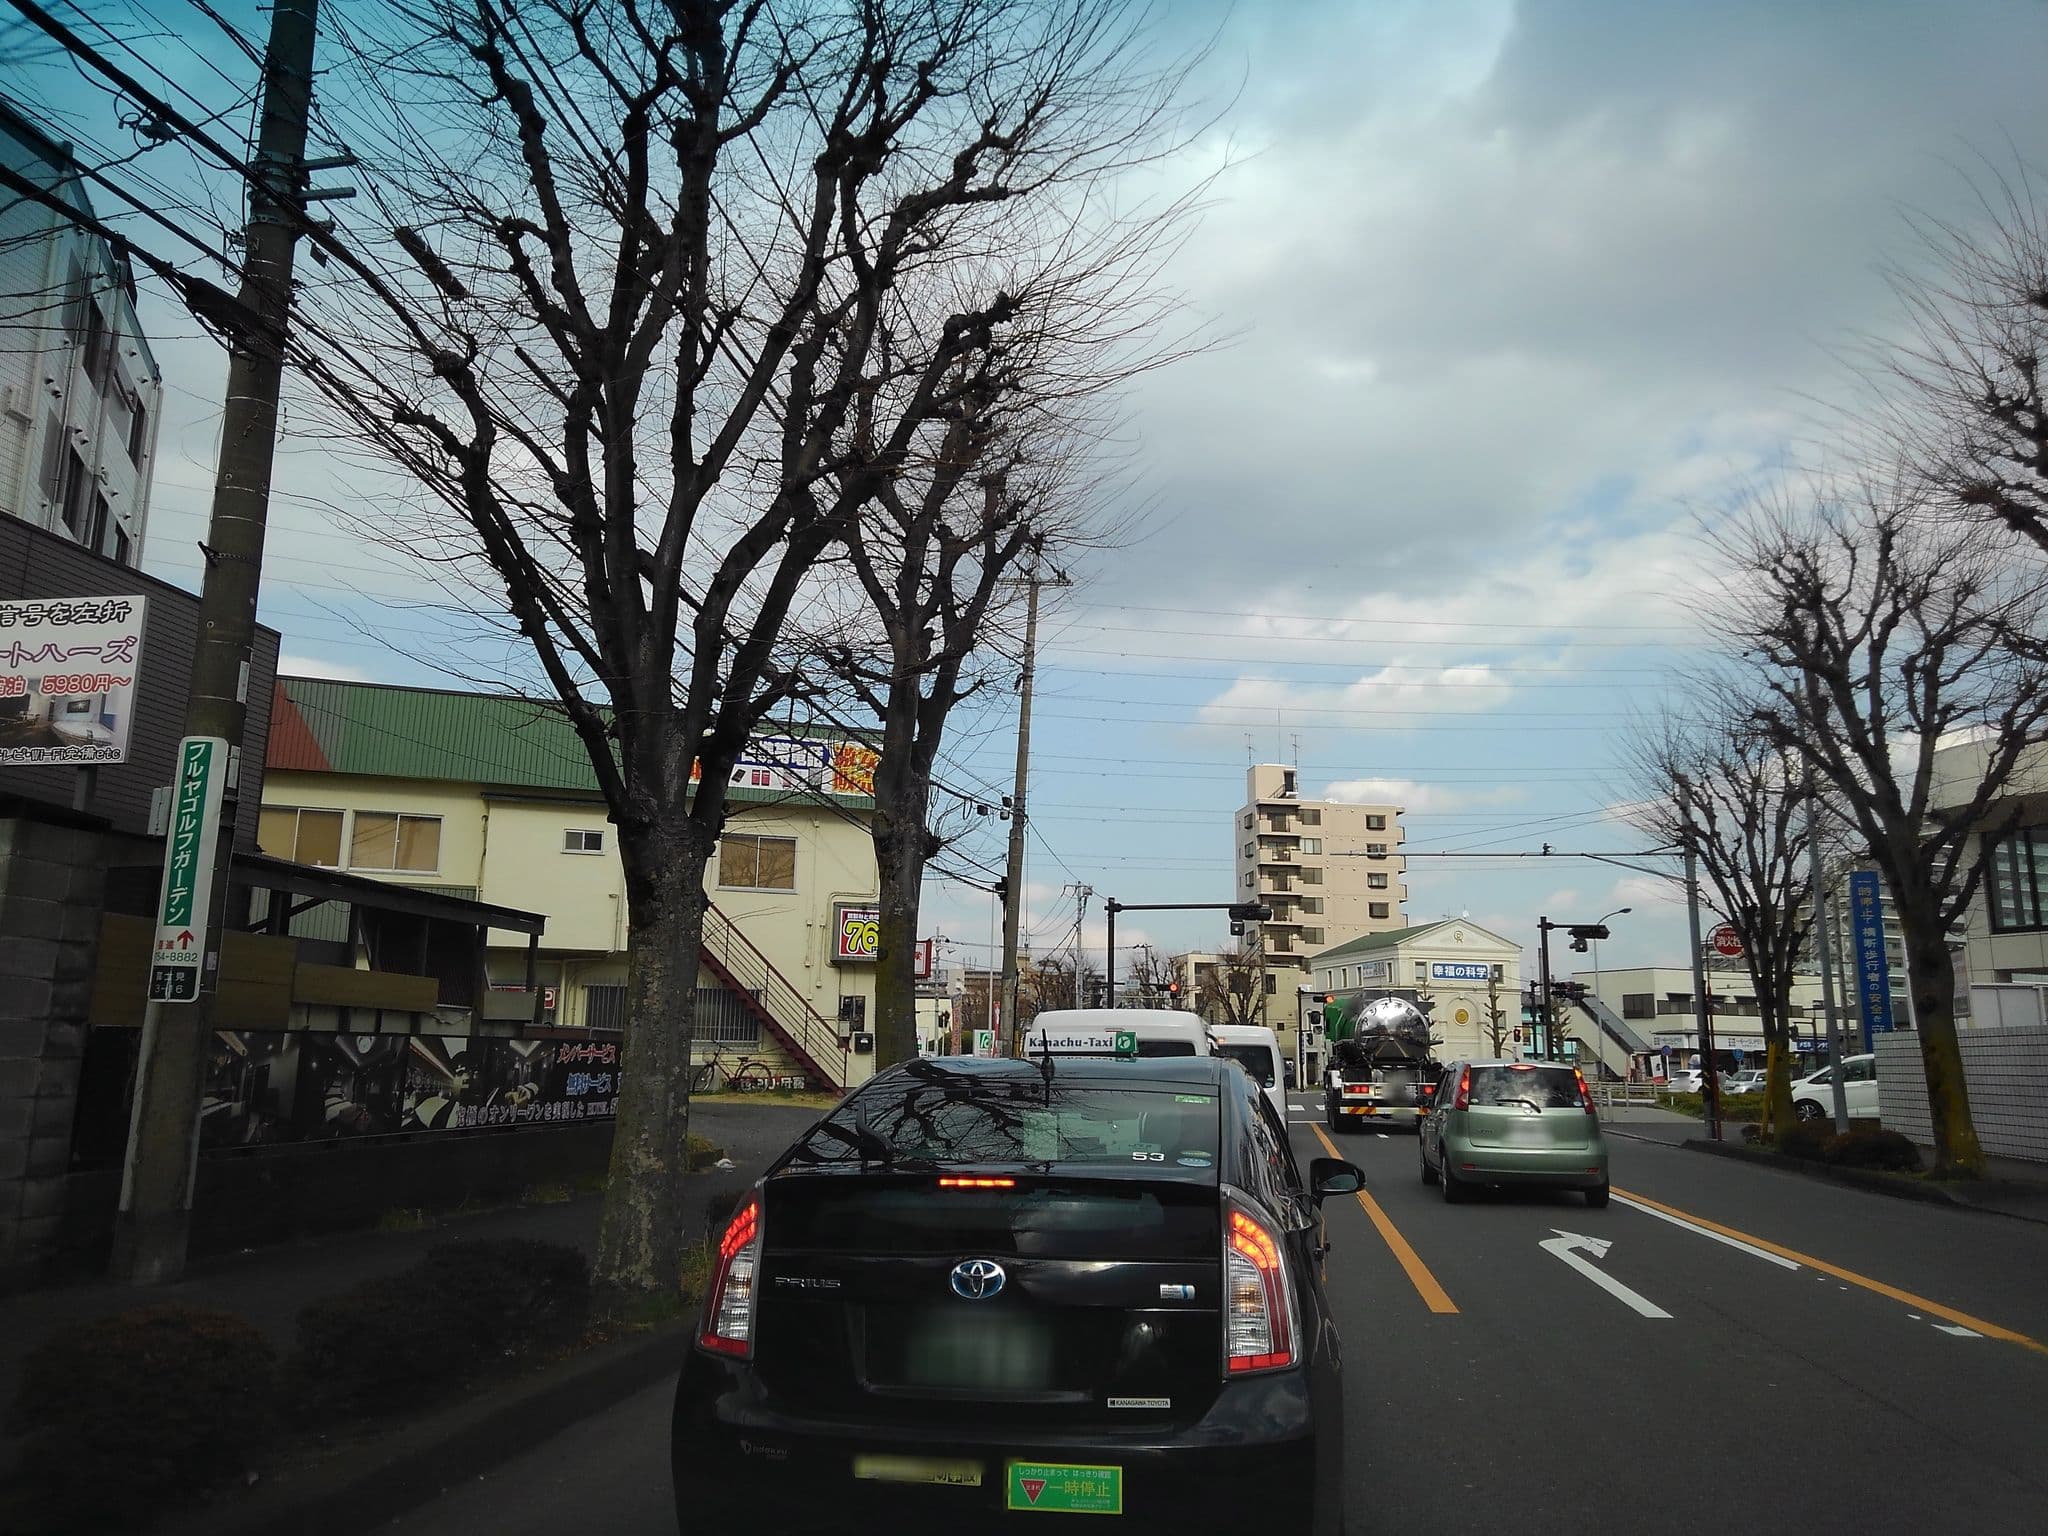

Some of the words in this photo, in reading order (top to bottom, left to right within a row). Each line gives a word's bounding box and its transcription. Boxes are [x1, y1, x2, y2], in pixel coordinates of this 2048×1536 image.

[0, 600, 131, 627] 信号を左折
[167, 743, 206, 925] フルヤゴルフガーデン
[1434, 965, 1487, 978] 幸福の科学
[1029, 1036, 1113, 1048] Kanachu-Taxi
[1132, 1152, 1165, 1161] 53
[775, 1277, 841, 1288] PRIUS
[1049, 1481, 1111, 1497] 一時停止
